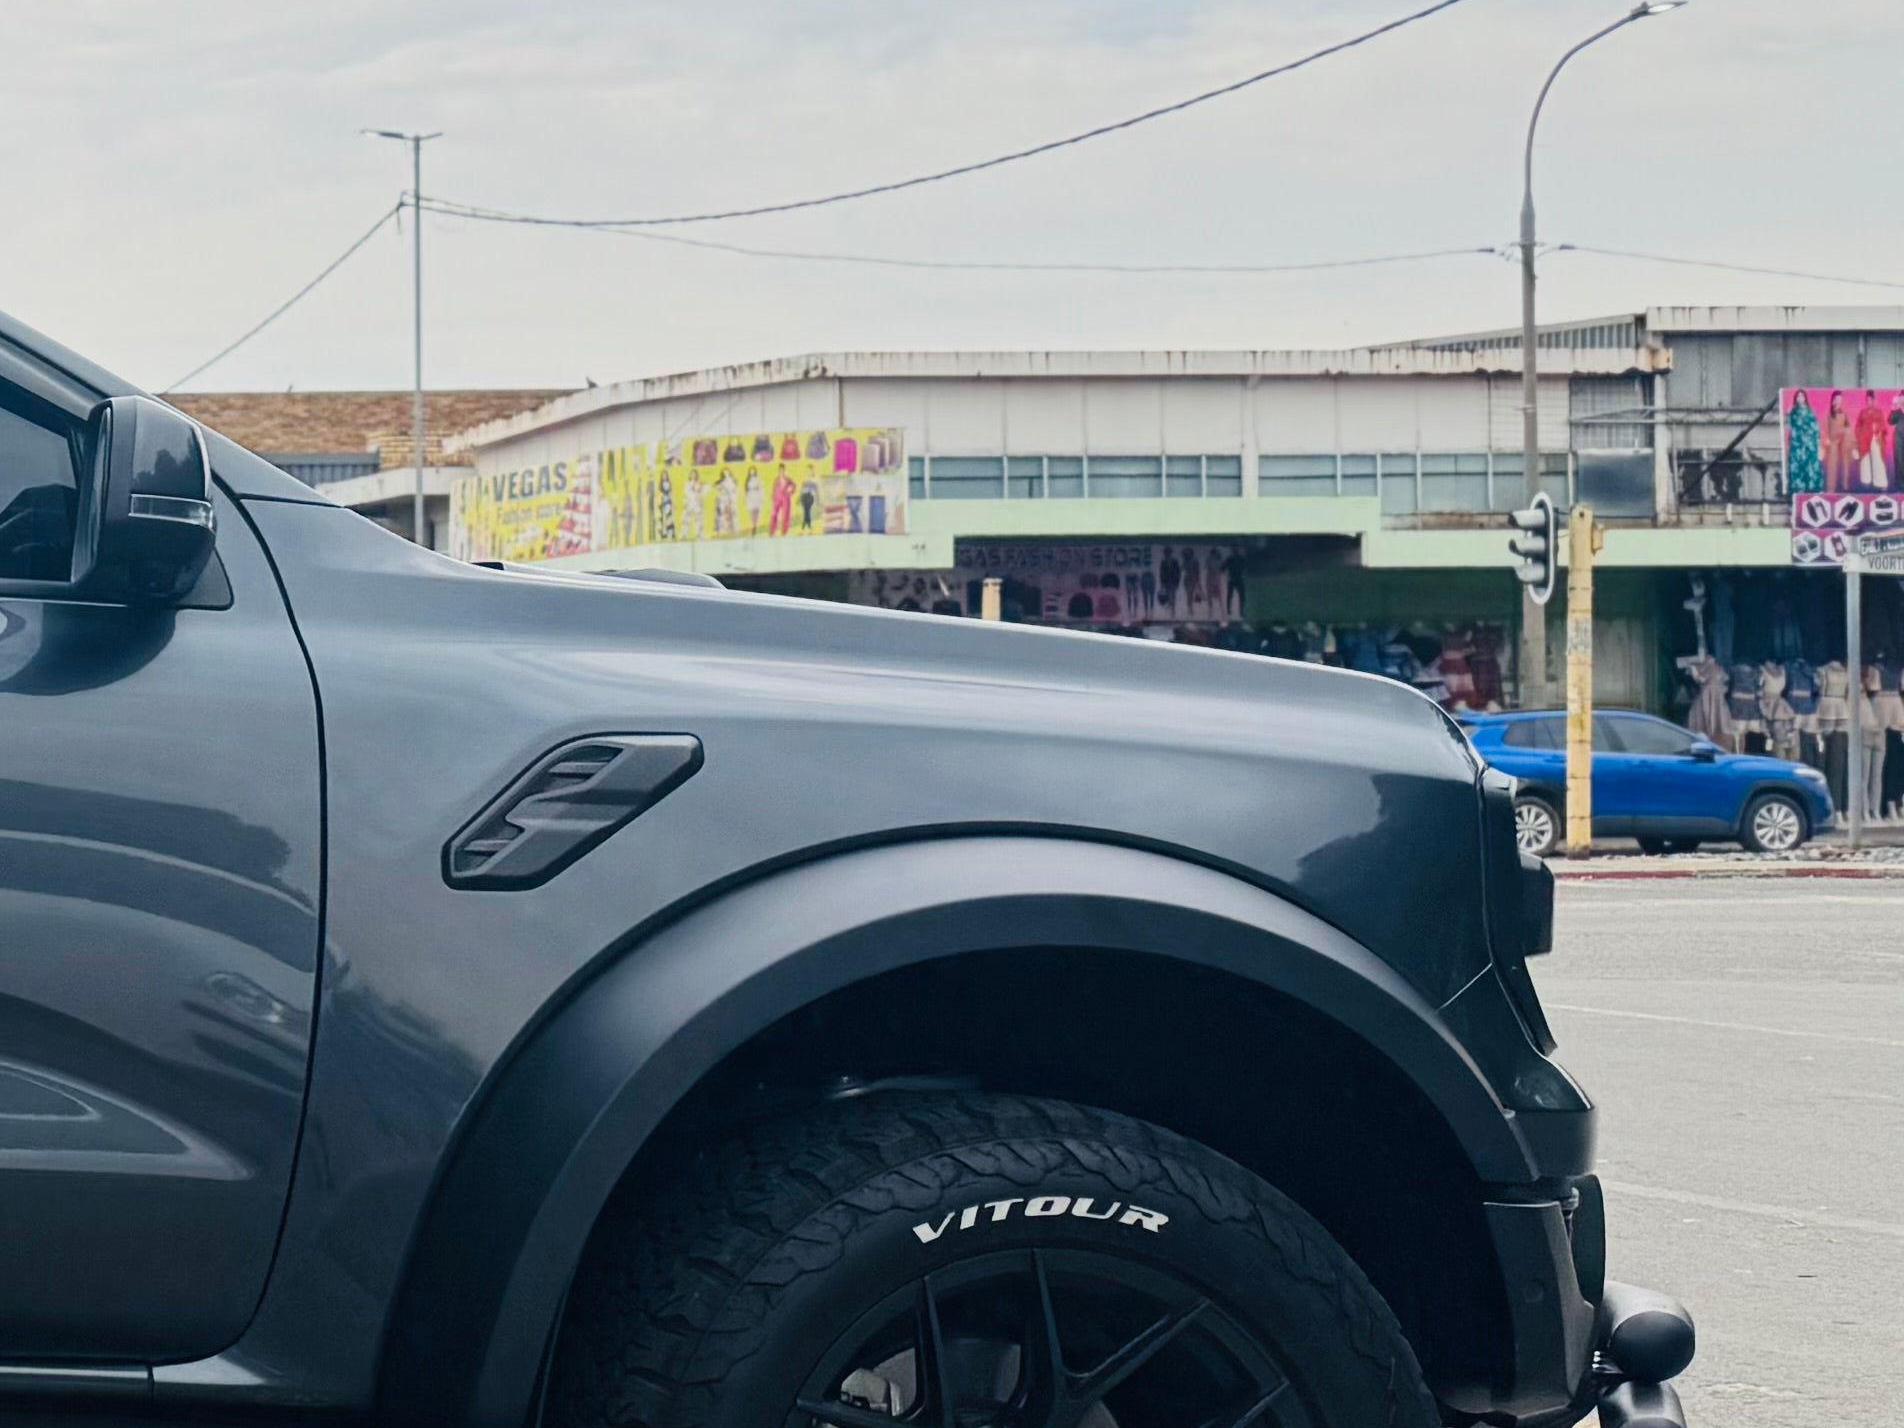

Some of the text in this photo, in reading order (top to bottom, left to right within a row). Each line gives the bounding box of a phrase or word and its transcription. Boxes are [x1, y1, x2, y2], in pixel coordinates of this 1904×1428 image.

[492, 461, 568, 502] VEGAS
[1090, 547, 1153, 567] STORE
[912, 1196, 1169, 1244] VITOUR
